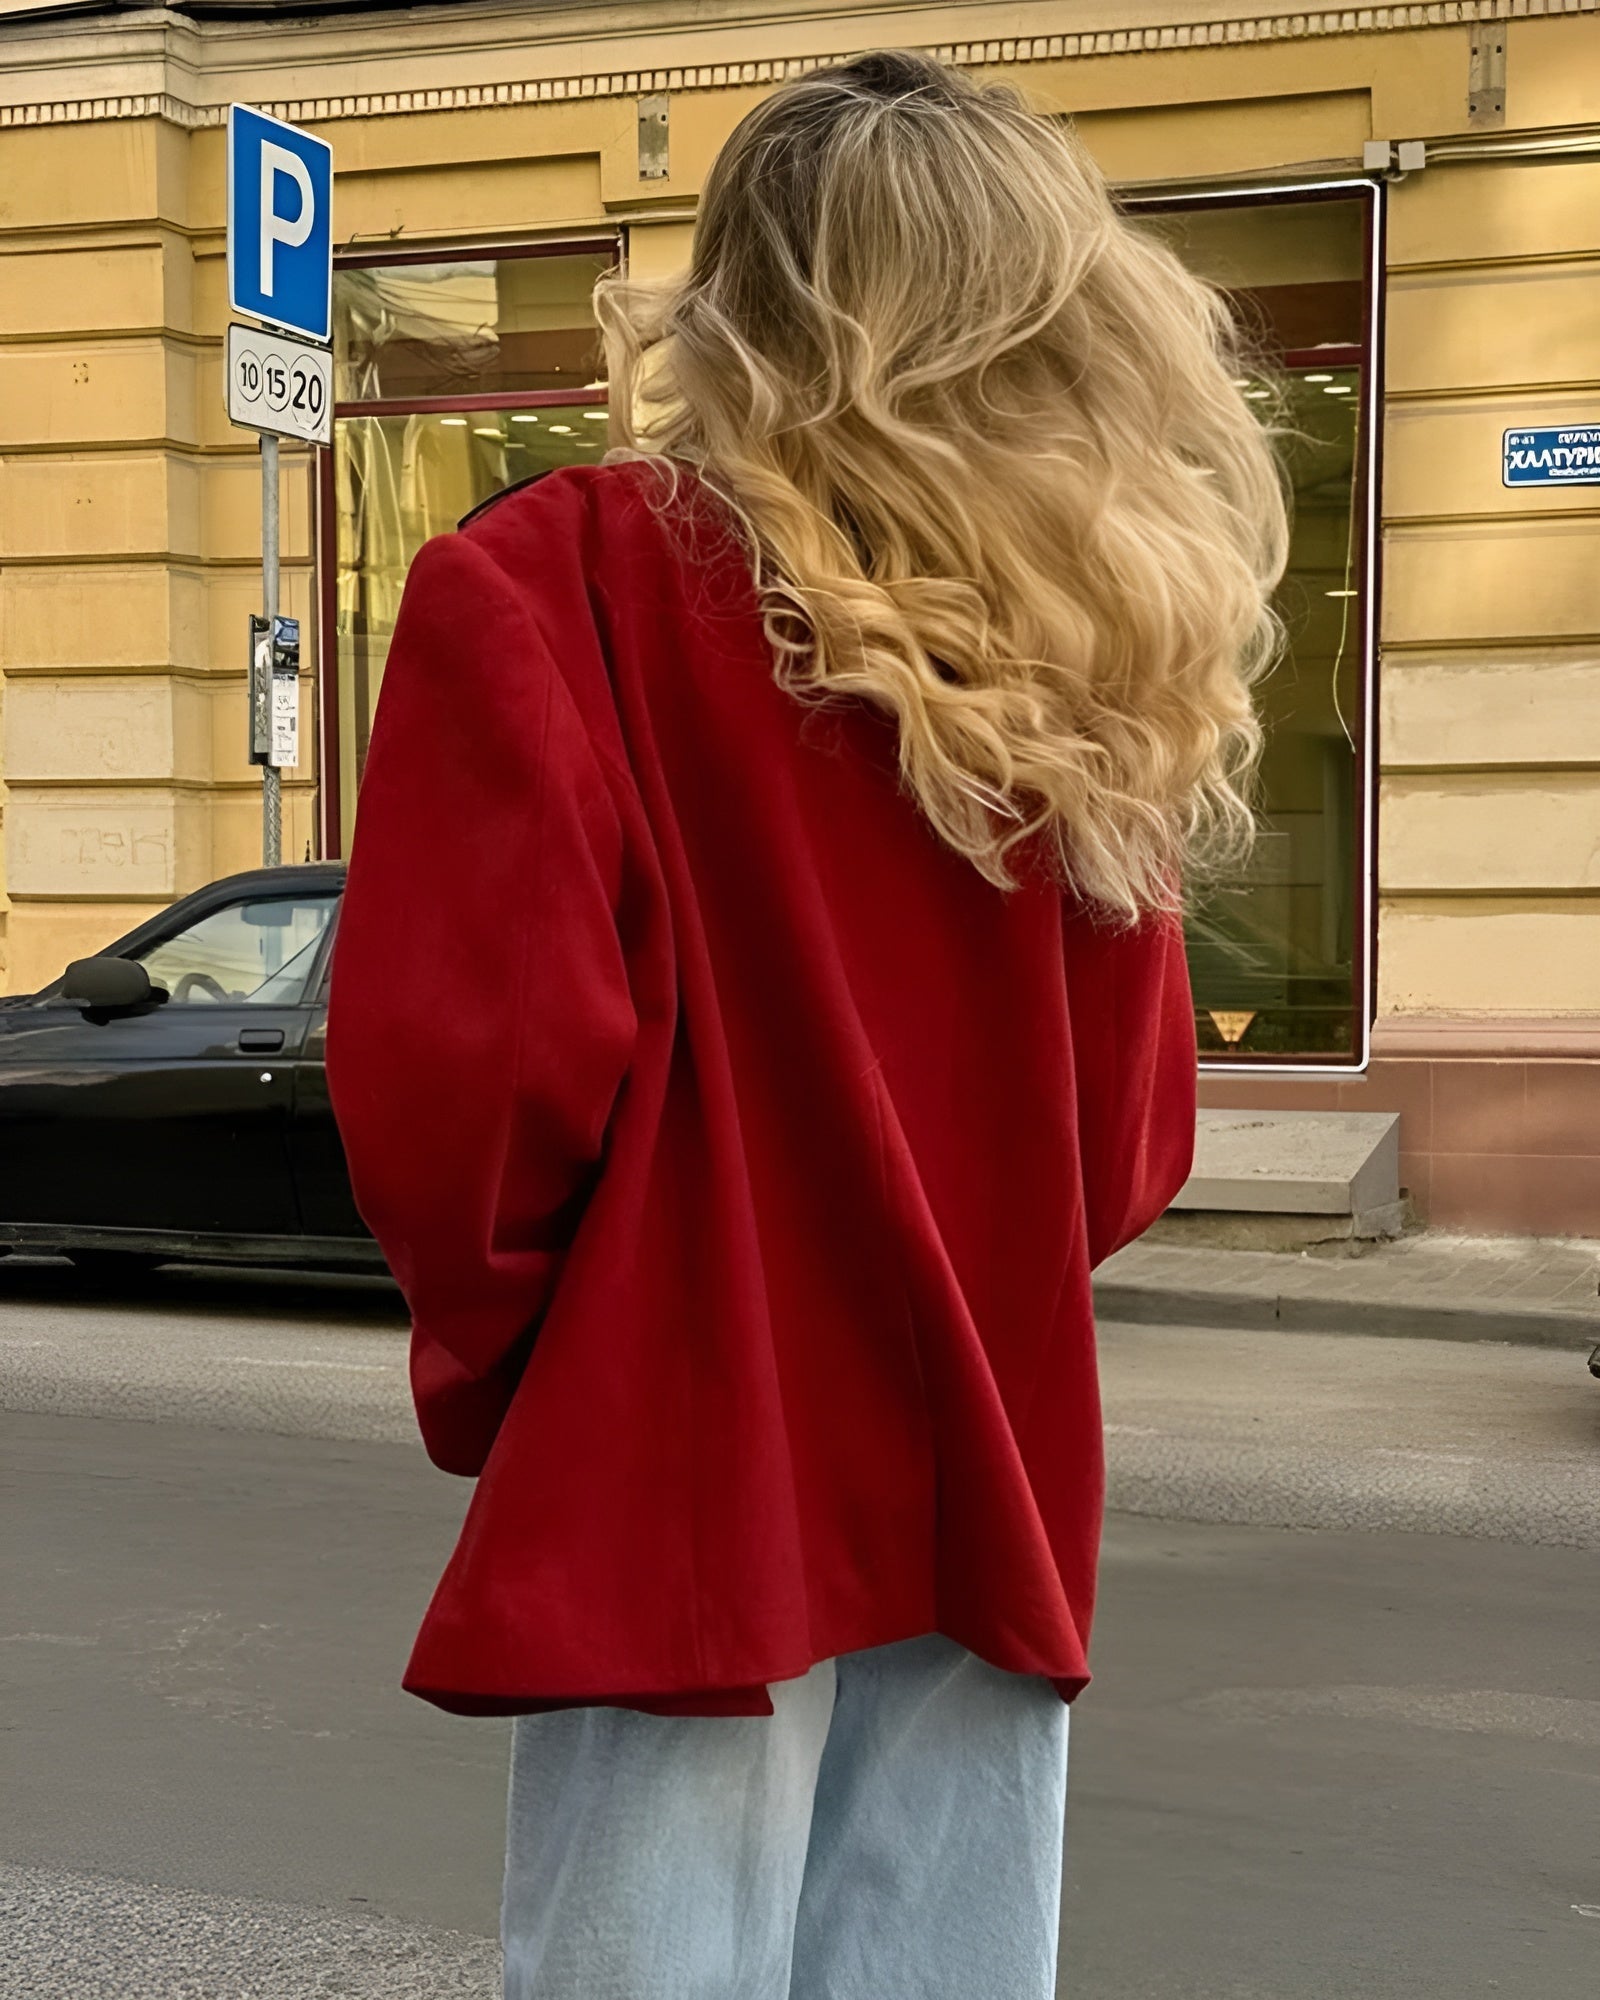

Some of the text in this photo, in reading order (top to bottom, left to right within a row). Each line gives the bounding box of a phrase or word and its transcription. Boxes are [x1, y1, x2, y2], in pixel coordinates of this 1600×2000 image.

[260, 138, 315, 298] P
[241, 362, 322, 414] 10 15 20
